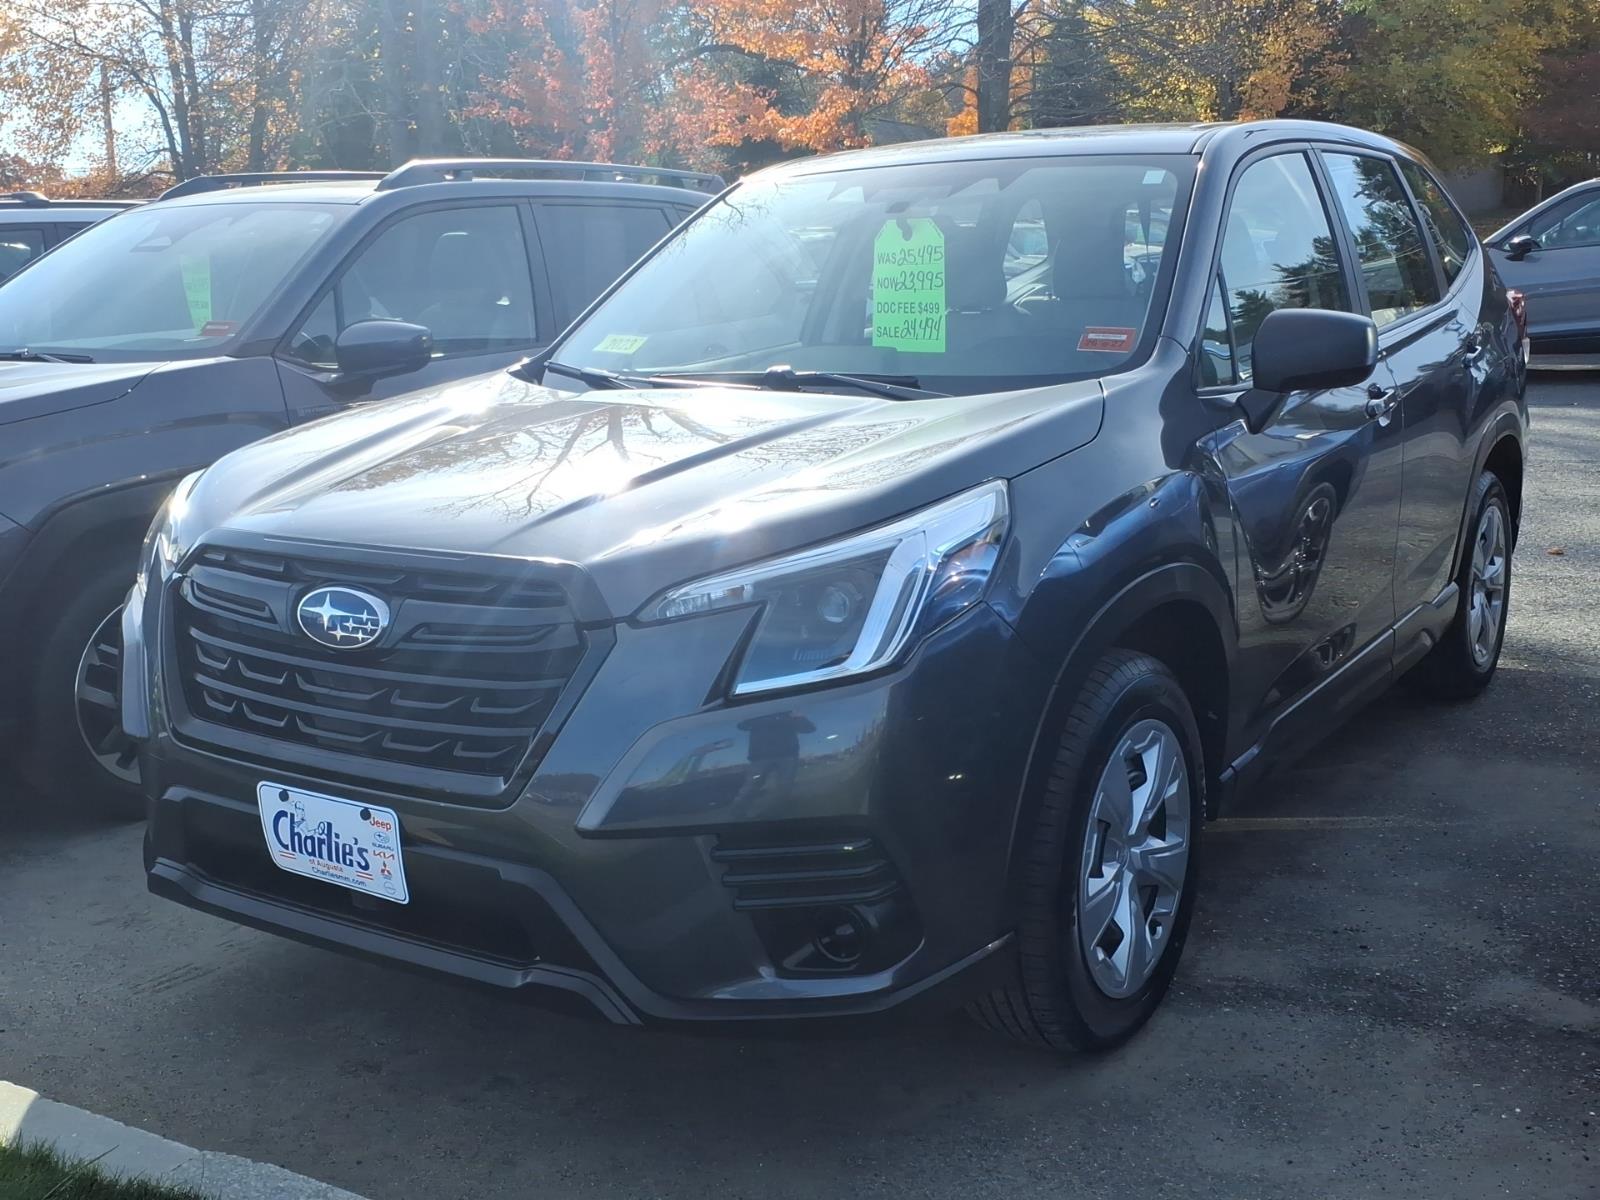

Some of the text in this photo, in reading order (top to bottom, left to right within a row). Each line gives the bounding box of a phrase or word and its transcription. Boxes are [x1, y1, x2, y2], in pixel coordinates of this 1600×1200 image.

[877, 252, 897, 264] WAS
[877, 270, 944, 293] NOW 23,995
[876, 302, 940, 314] DOC FEE $499
[876, 326, 900, 338] SALE
[369, 816, 392, 831] Jeep
[272, 809, 371, 871] Charlie's
